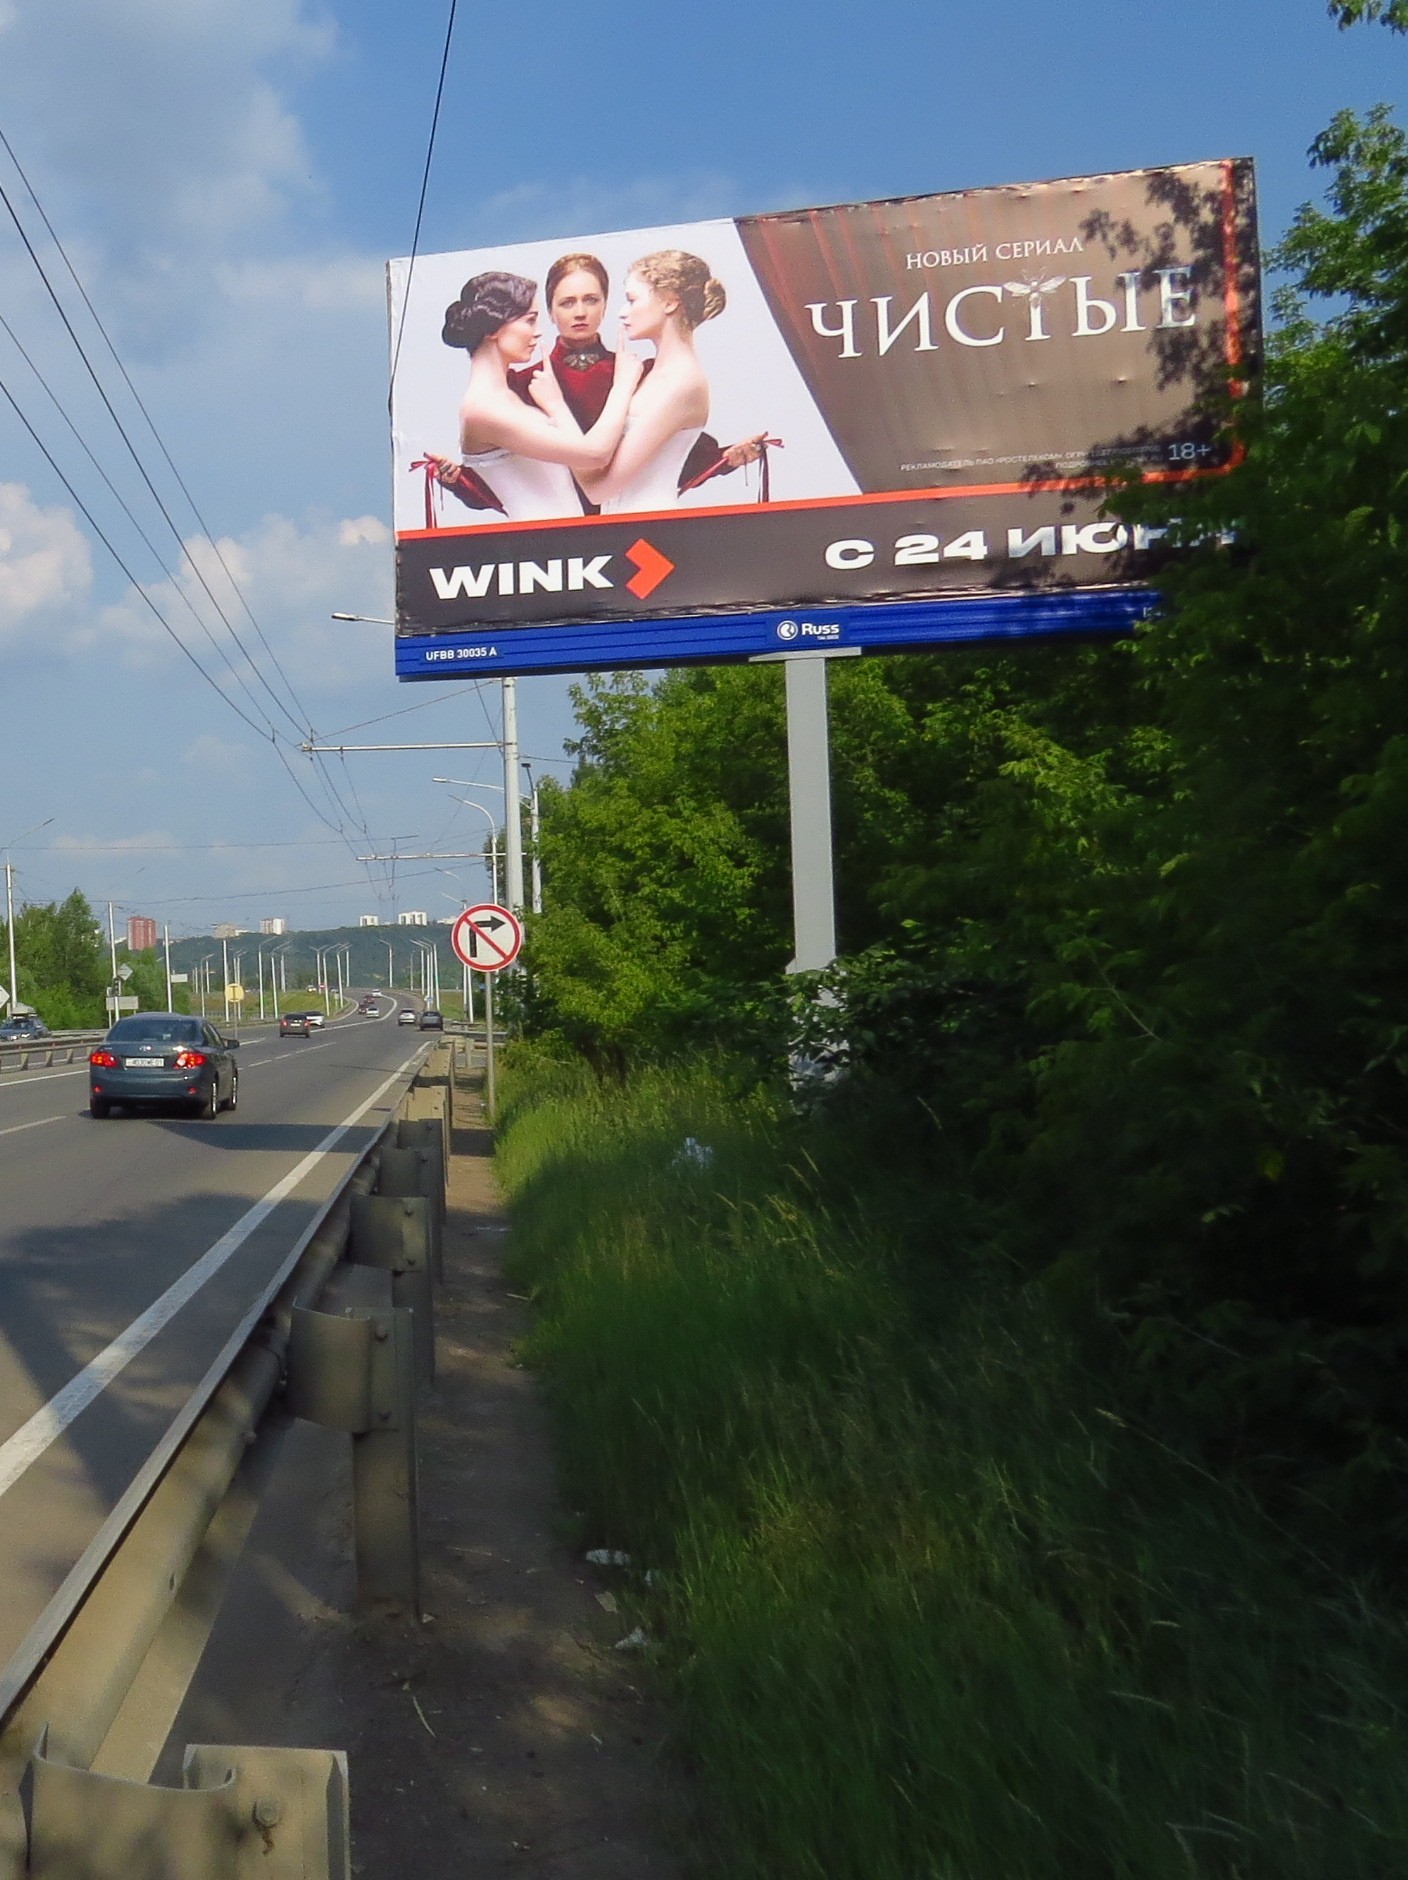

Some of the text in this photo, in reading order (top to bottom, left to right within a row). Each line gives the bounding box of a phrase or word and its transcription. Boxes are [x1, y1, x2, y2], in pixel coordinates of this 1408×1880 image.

[906, 237, 1084, 269] НОВЫЙ СЕРИАЛ
[804, 264, 1196, 358] ЧИСТЫЕ
[1168, 442, 1211, 461] 18+
[825, 539, 875, 570] С
[894, 530, 988, 566] 24
[429, 554, 614, 600] WINK
[801, 623, 840, 636] Russ
[425, 649, 455, 661] UFBB
[456, 647, 488, 659] 30035
